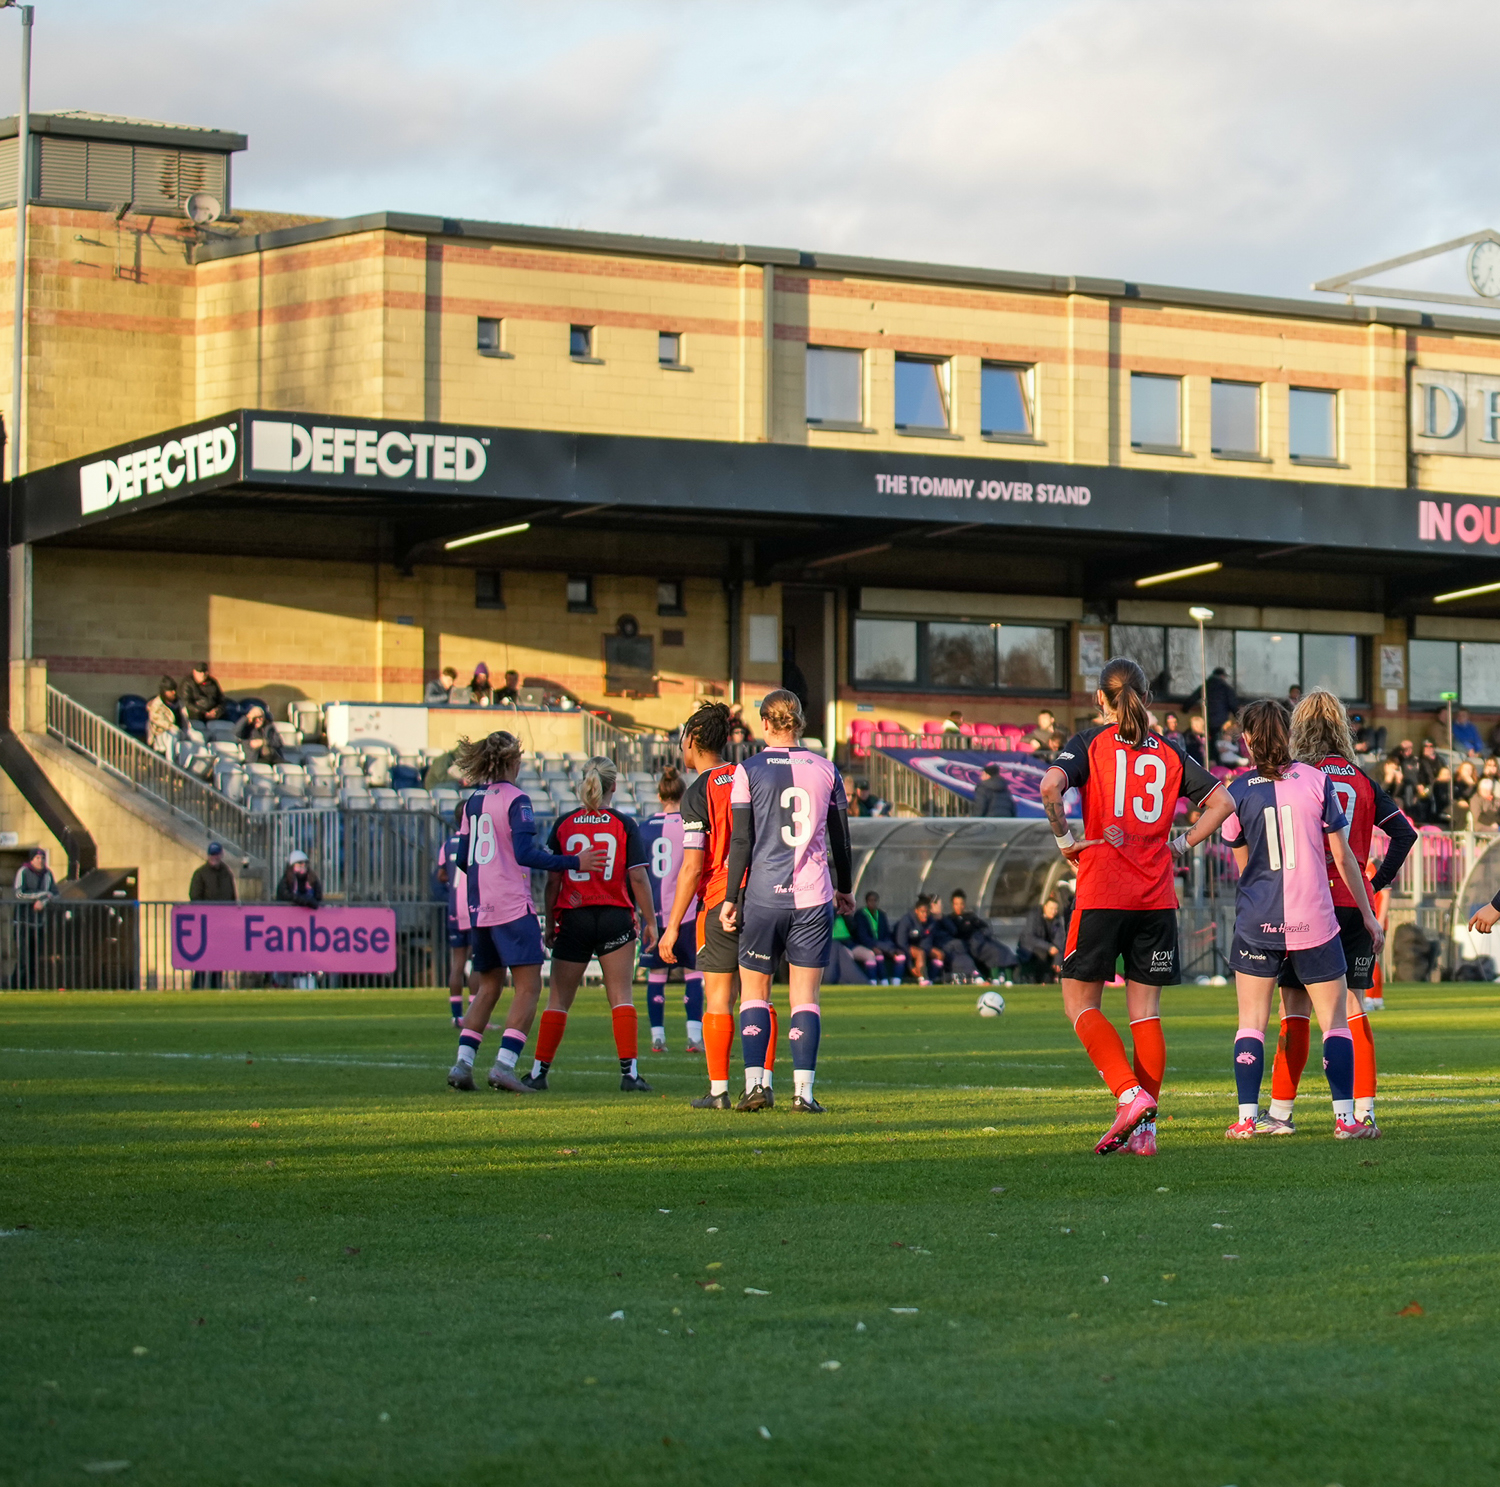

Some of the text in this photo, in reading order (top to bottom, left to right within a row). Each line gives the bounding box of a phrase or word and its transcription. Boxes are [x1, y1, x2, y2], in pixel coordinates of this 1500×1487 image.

[80, 426, 237, 515] DEFECTED
[252, 420, 487, 481] DEFECTED
[876, 474, 1091, 506] THE TOMMY JOVER STAND
[1419, 500, 1453, 541] IN
[1114, 749, 1167, 824] 13
[468, 812, 495, 866] 18
[574, 815, 601, 824] utilita
[780, 786, 811, 847] 3
[1264, 805, 1296, 871] 11
[566, 833, 617, 882] 27
[652, 836, 672, 878] 8
[773, 884, 787, 894] The
[244, 915, 390, 953] Fanbase
[1260, 921, 1310, 933] The Hamlet
